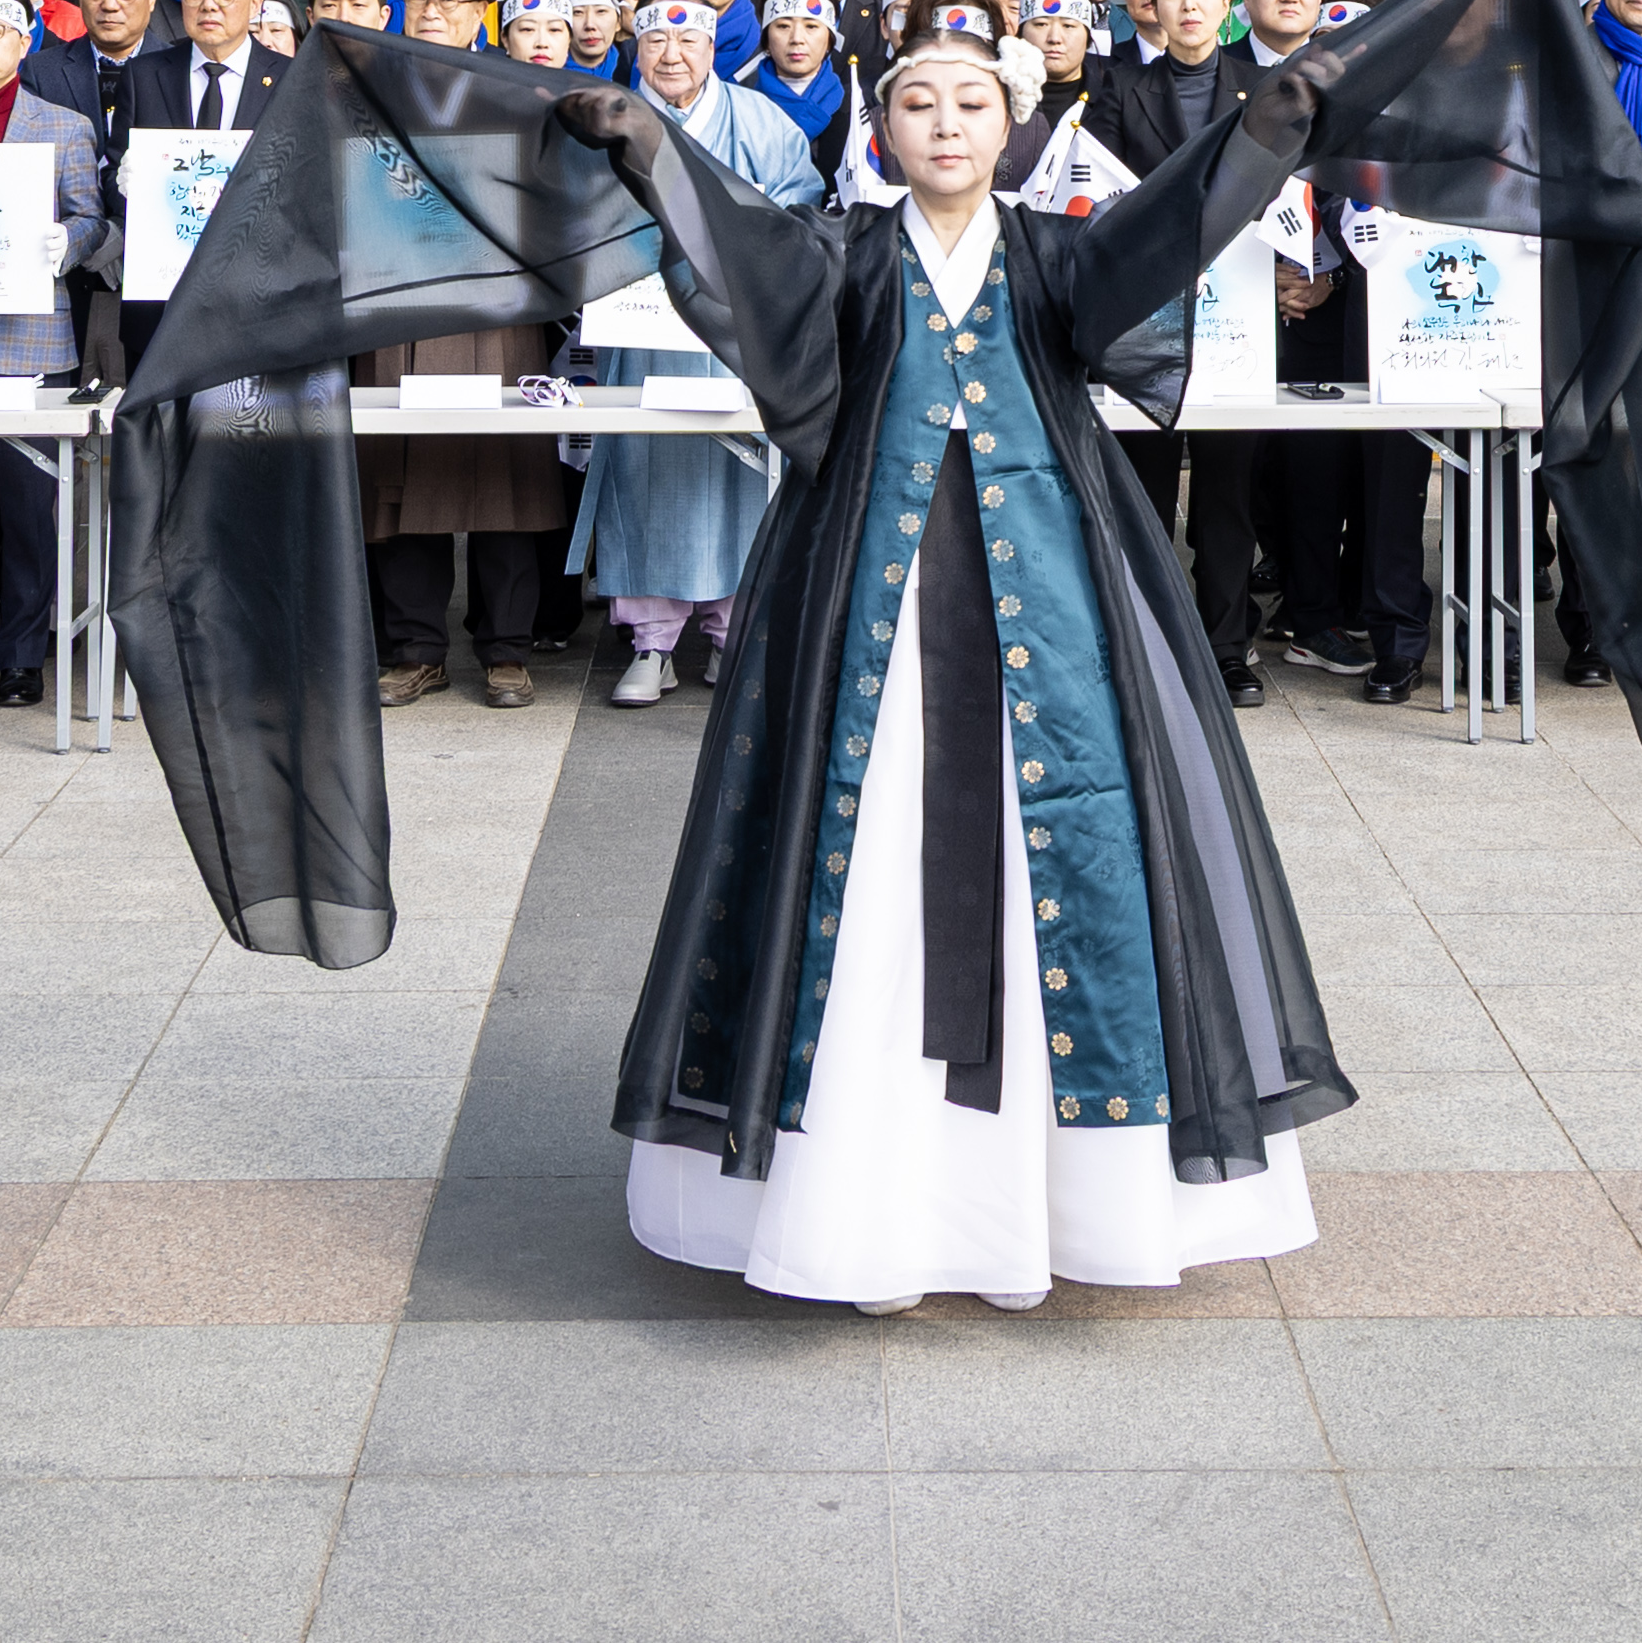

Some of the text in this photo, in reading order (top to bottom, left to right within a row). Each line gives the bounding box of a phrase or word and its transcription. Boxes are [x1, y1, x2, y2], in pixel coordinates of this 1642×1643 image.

[635, 5, 662, 30] 大韓
[1423, 244, 1488, 276] 대한
[1429, 274, 1495, 314] 독립
